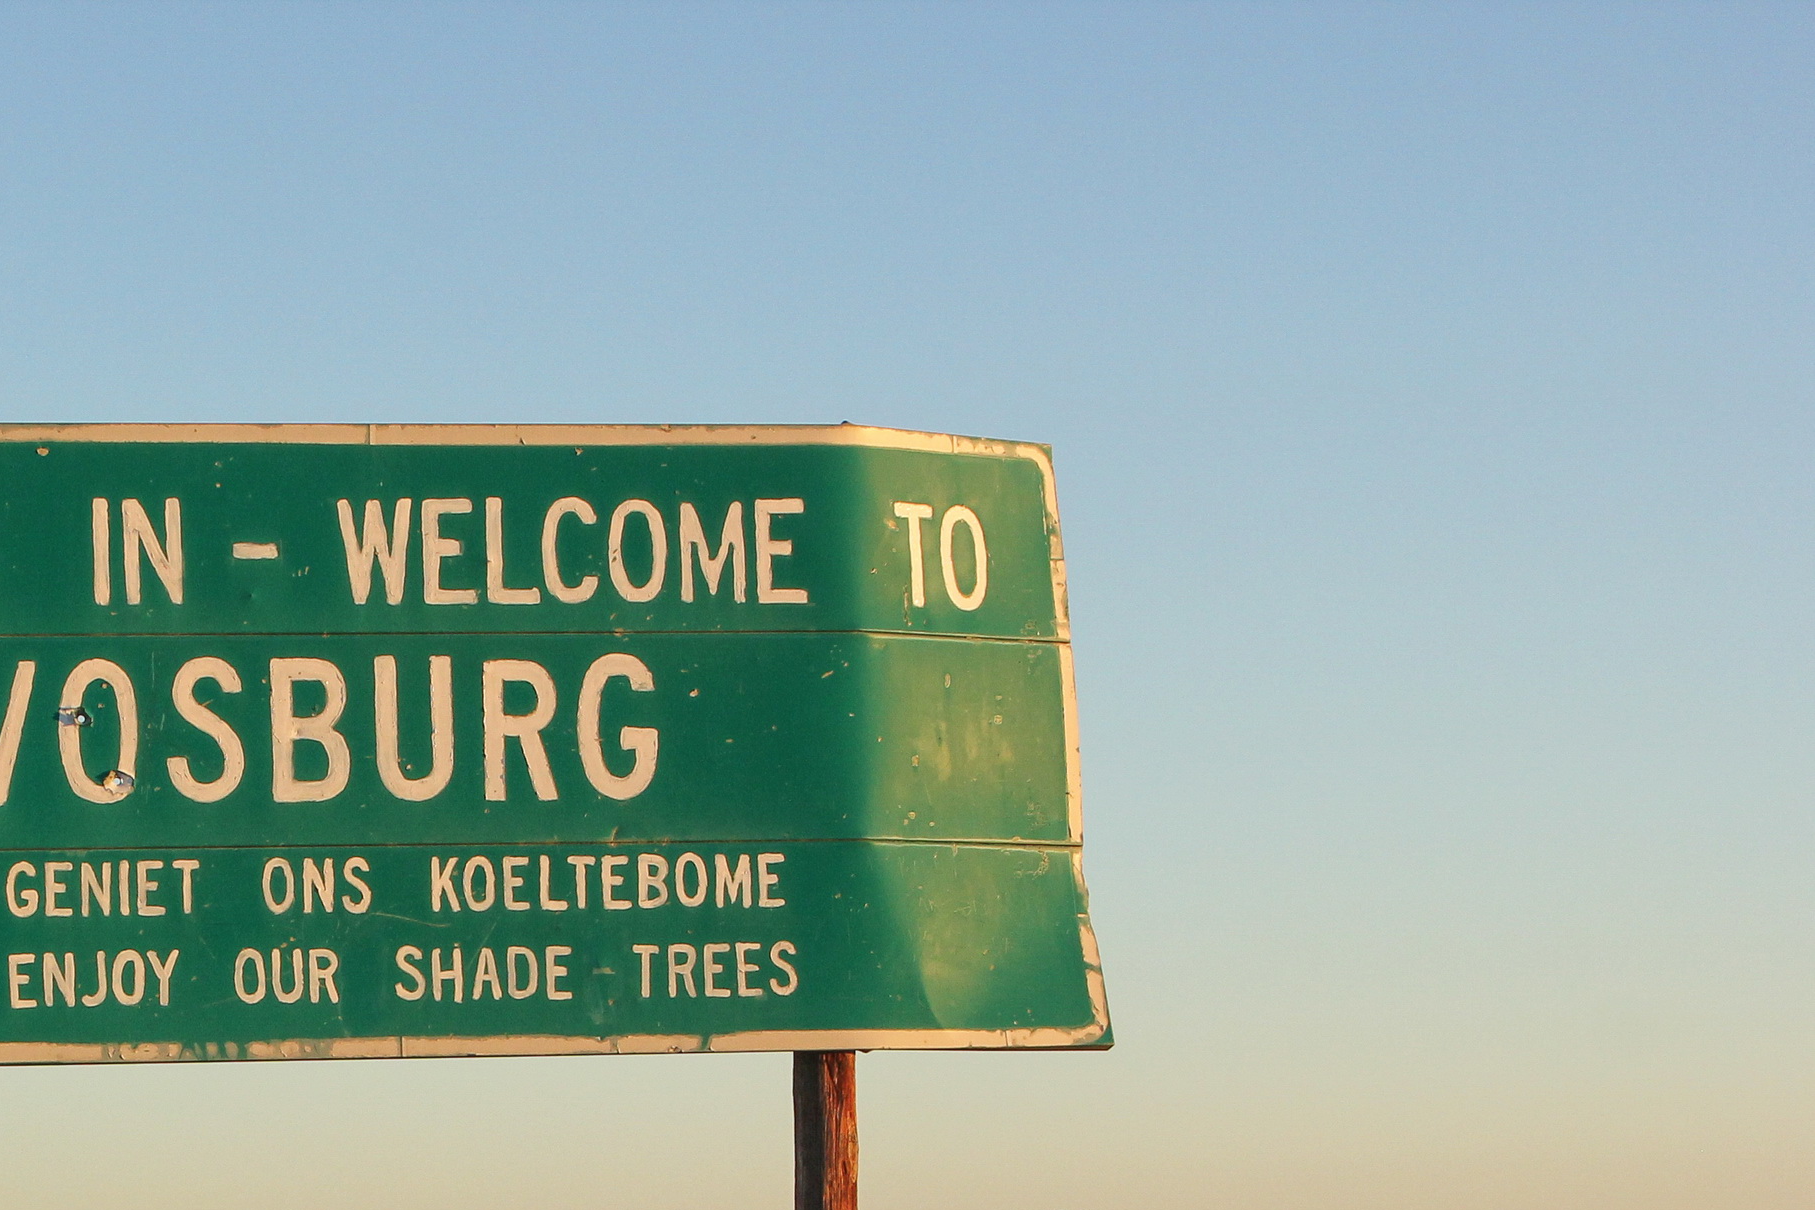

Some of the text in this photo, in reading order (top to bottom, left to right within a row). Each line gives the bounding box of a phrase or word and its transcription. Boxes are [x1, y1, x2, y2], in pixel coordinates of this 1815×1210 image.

[91, 498, 184, 607] IN
[232, 542, 278, 559] -
[337, 496, 809, 606] WELCOME
[893, 501, 988, 612] TO
[5, 859, 201, 918] GENIET
[262, 857, 372, 915] ONS
[430, 851, 786, 912] KOELTEBOME
[9, 949, 181, 1010] ENJOY
[234, 946, 340, 1006] OUR
[394, 945, 573, 1004] SHADE
[632, 940, 798, 1000] TREES
